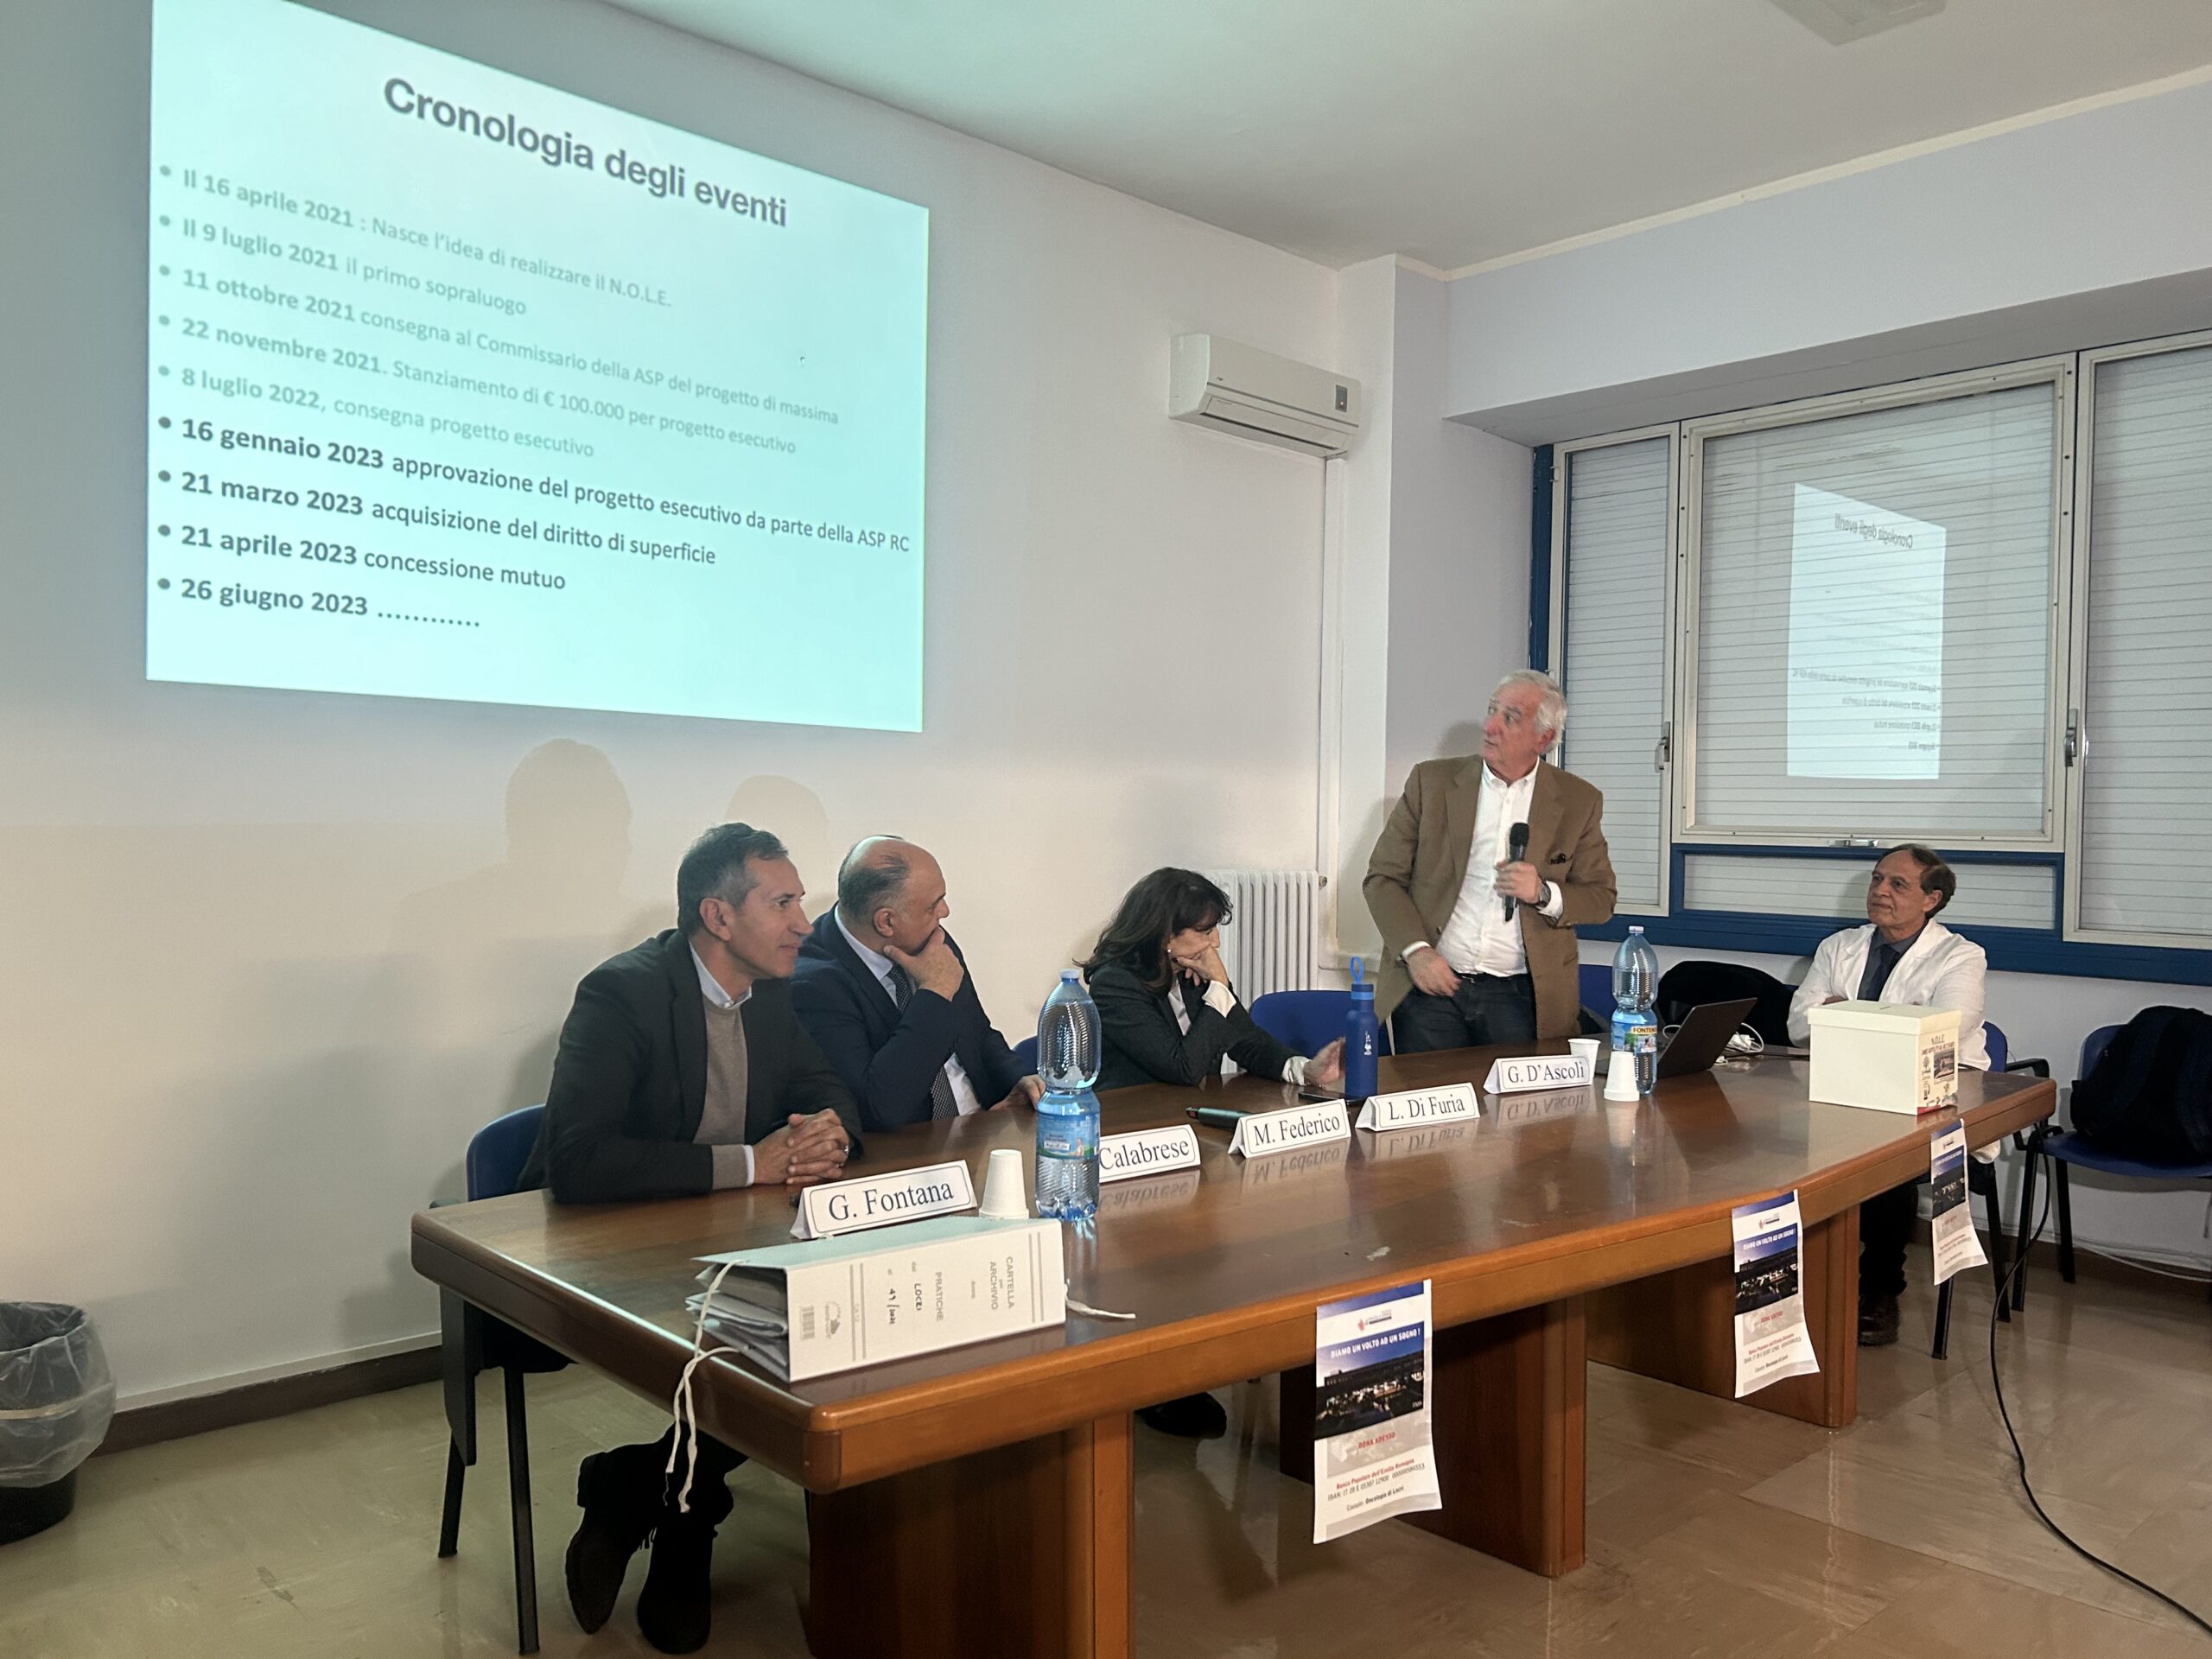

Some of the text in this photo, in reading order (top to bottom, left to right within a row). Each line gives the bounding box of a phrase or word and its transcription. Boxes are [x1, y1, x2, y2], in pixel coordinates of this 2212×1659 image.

[384, 78, 787, 227] Cronologia degli eventi
[183, 169, 196, 188] Il
[204, 175, 230, 196] 16
[237, 185, 298, 213] aprile
[303, 200, 354, 228] 2021
[372, 218, 429, 246] Nasce
[489, 248, 505, 267] di
[511, 257, 591, 288] realizzare
[596, 273, 606, 291] il
[609, 277, 672, 308] N.O.L.E.
[183, 219, 526, 315] Il 9 luglio 2021 il primo sopraluogo
[183, 269, 838, 425] 11 ottobre 2021 consegna al Commissario della ASP del progetto di massima
[181, 368, 594, 457] 8 luglio 2022, consegna progetto esecutivo
[182, 319, 796, 454] 22 novembre 2021. Stanziamento di € 100.000 per progetto esecutivo
[182, 419, 910, 552] 16 gennaio 2023 approvazione del progetto esecutivo da parte della ASP RC
[181, 472, 716, 564] 21 marzo 2023 acquisizione del diritto di superficie
[181, 524, 566, 589] 21 aprile 2023 concessione mutuo
[181, 578, 213, 600] 26
[219, 582, 303, 611] giugno
[311, 592, 368, 615] 2023
[1507, 1065, 1523, 1084] G.
[1253, 1113, 1341, 1146] M. Federico
[1388, 1095, 1465, 1121] L. Di Furia
[1099, 1137, 1191, 1170] Calabrese
[828, 1181, 954, 1222] G. Fontana
[935, 1271, 944, 1321] PRATICHE
[989, 1261, 999, 1311] ARCHIVIO
[1006, 1255, 1014, 1309] CARTELLA
[1331, 1346, 1351, 1358] DIAMO
[1351, 1344, 1361, 1353] UN
[1362, 1338, 1380, 1350] VOLTO
[1380, 1337, 1389, 1345] AD
[1389, 1334, 1398, 1344] UN
[1399, 1328, 1417, 1341] SOGNO
[1358, 1431, 1396, 1450] DONA ADESSO
